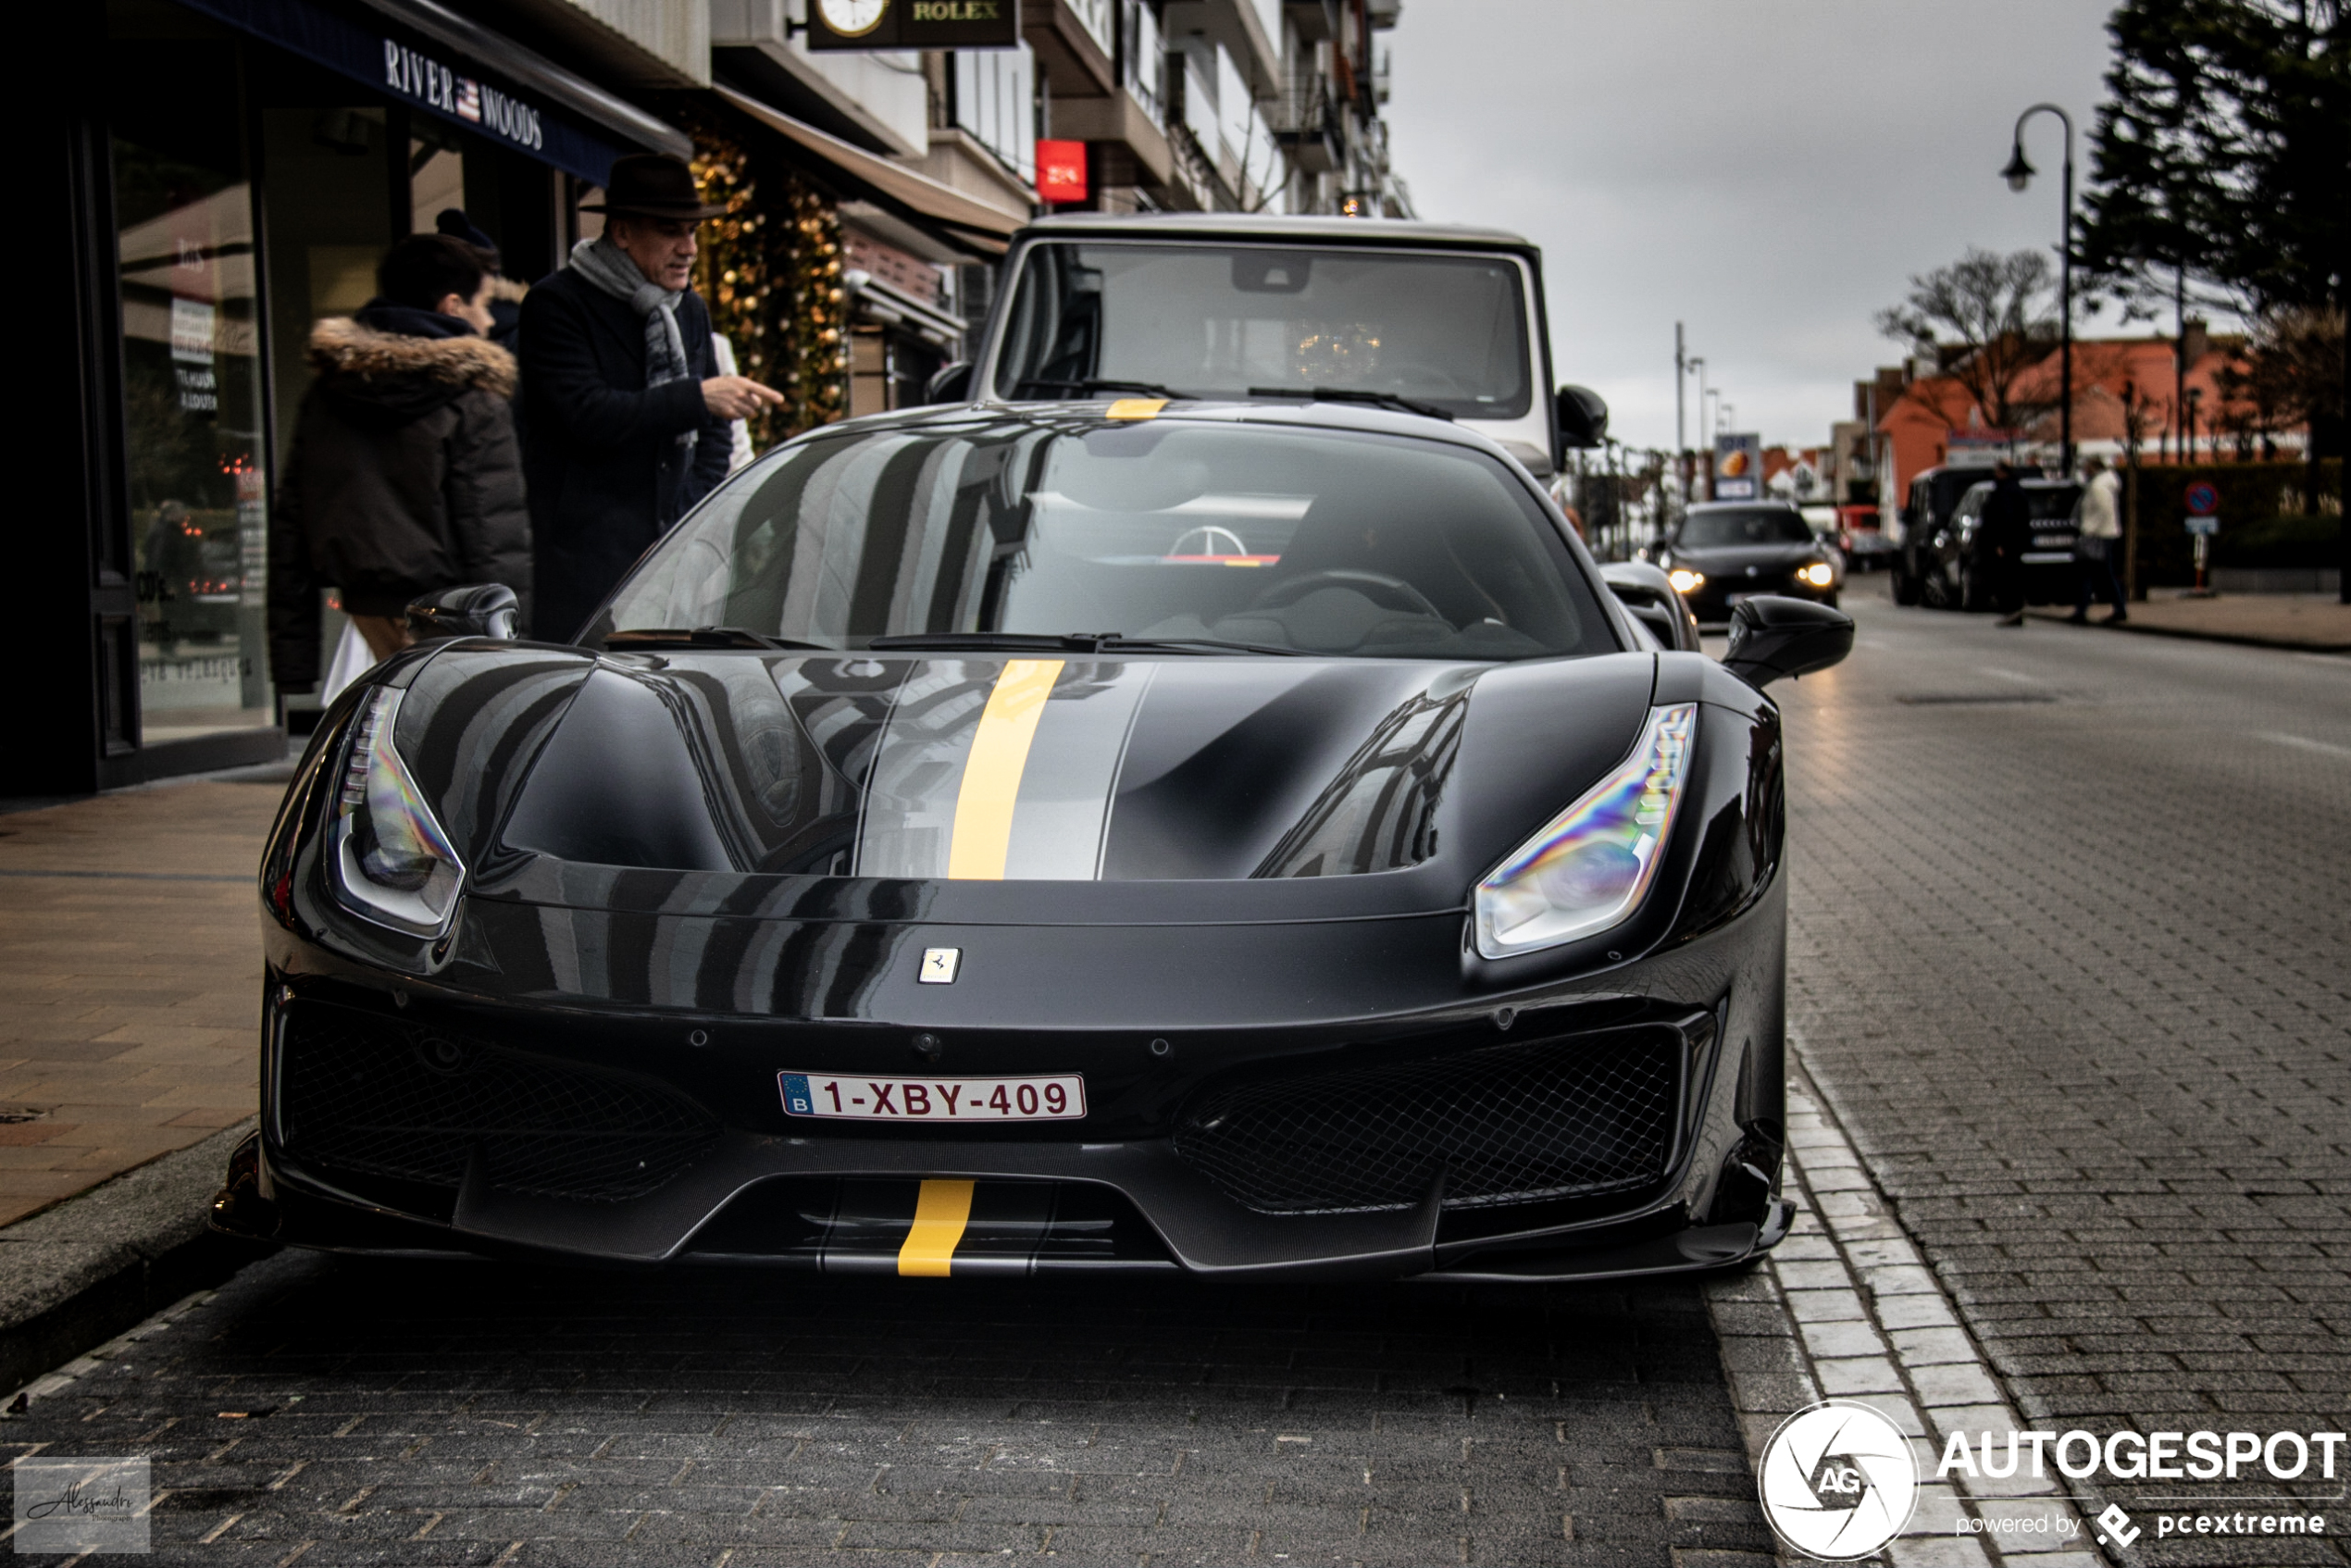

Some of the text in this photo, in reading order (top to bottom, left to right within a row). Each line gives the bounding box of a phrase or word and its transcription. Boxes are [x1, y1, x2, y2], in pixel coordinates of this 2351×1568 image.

[914, 2, 999, 20] ROLEX
[384, 39, 542, 151] RIVER WOODS
[792, 1081, 1068, 1116] B 1-XBY-409
